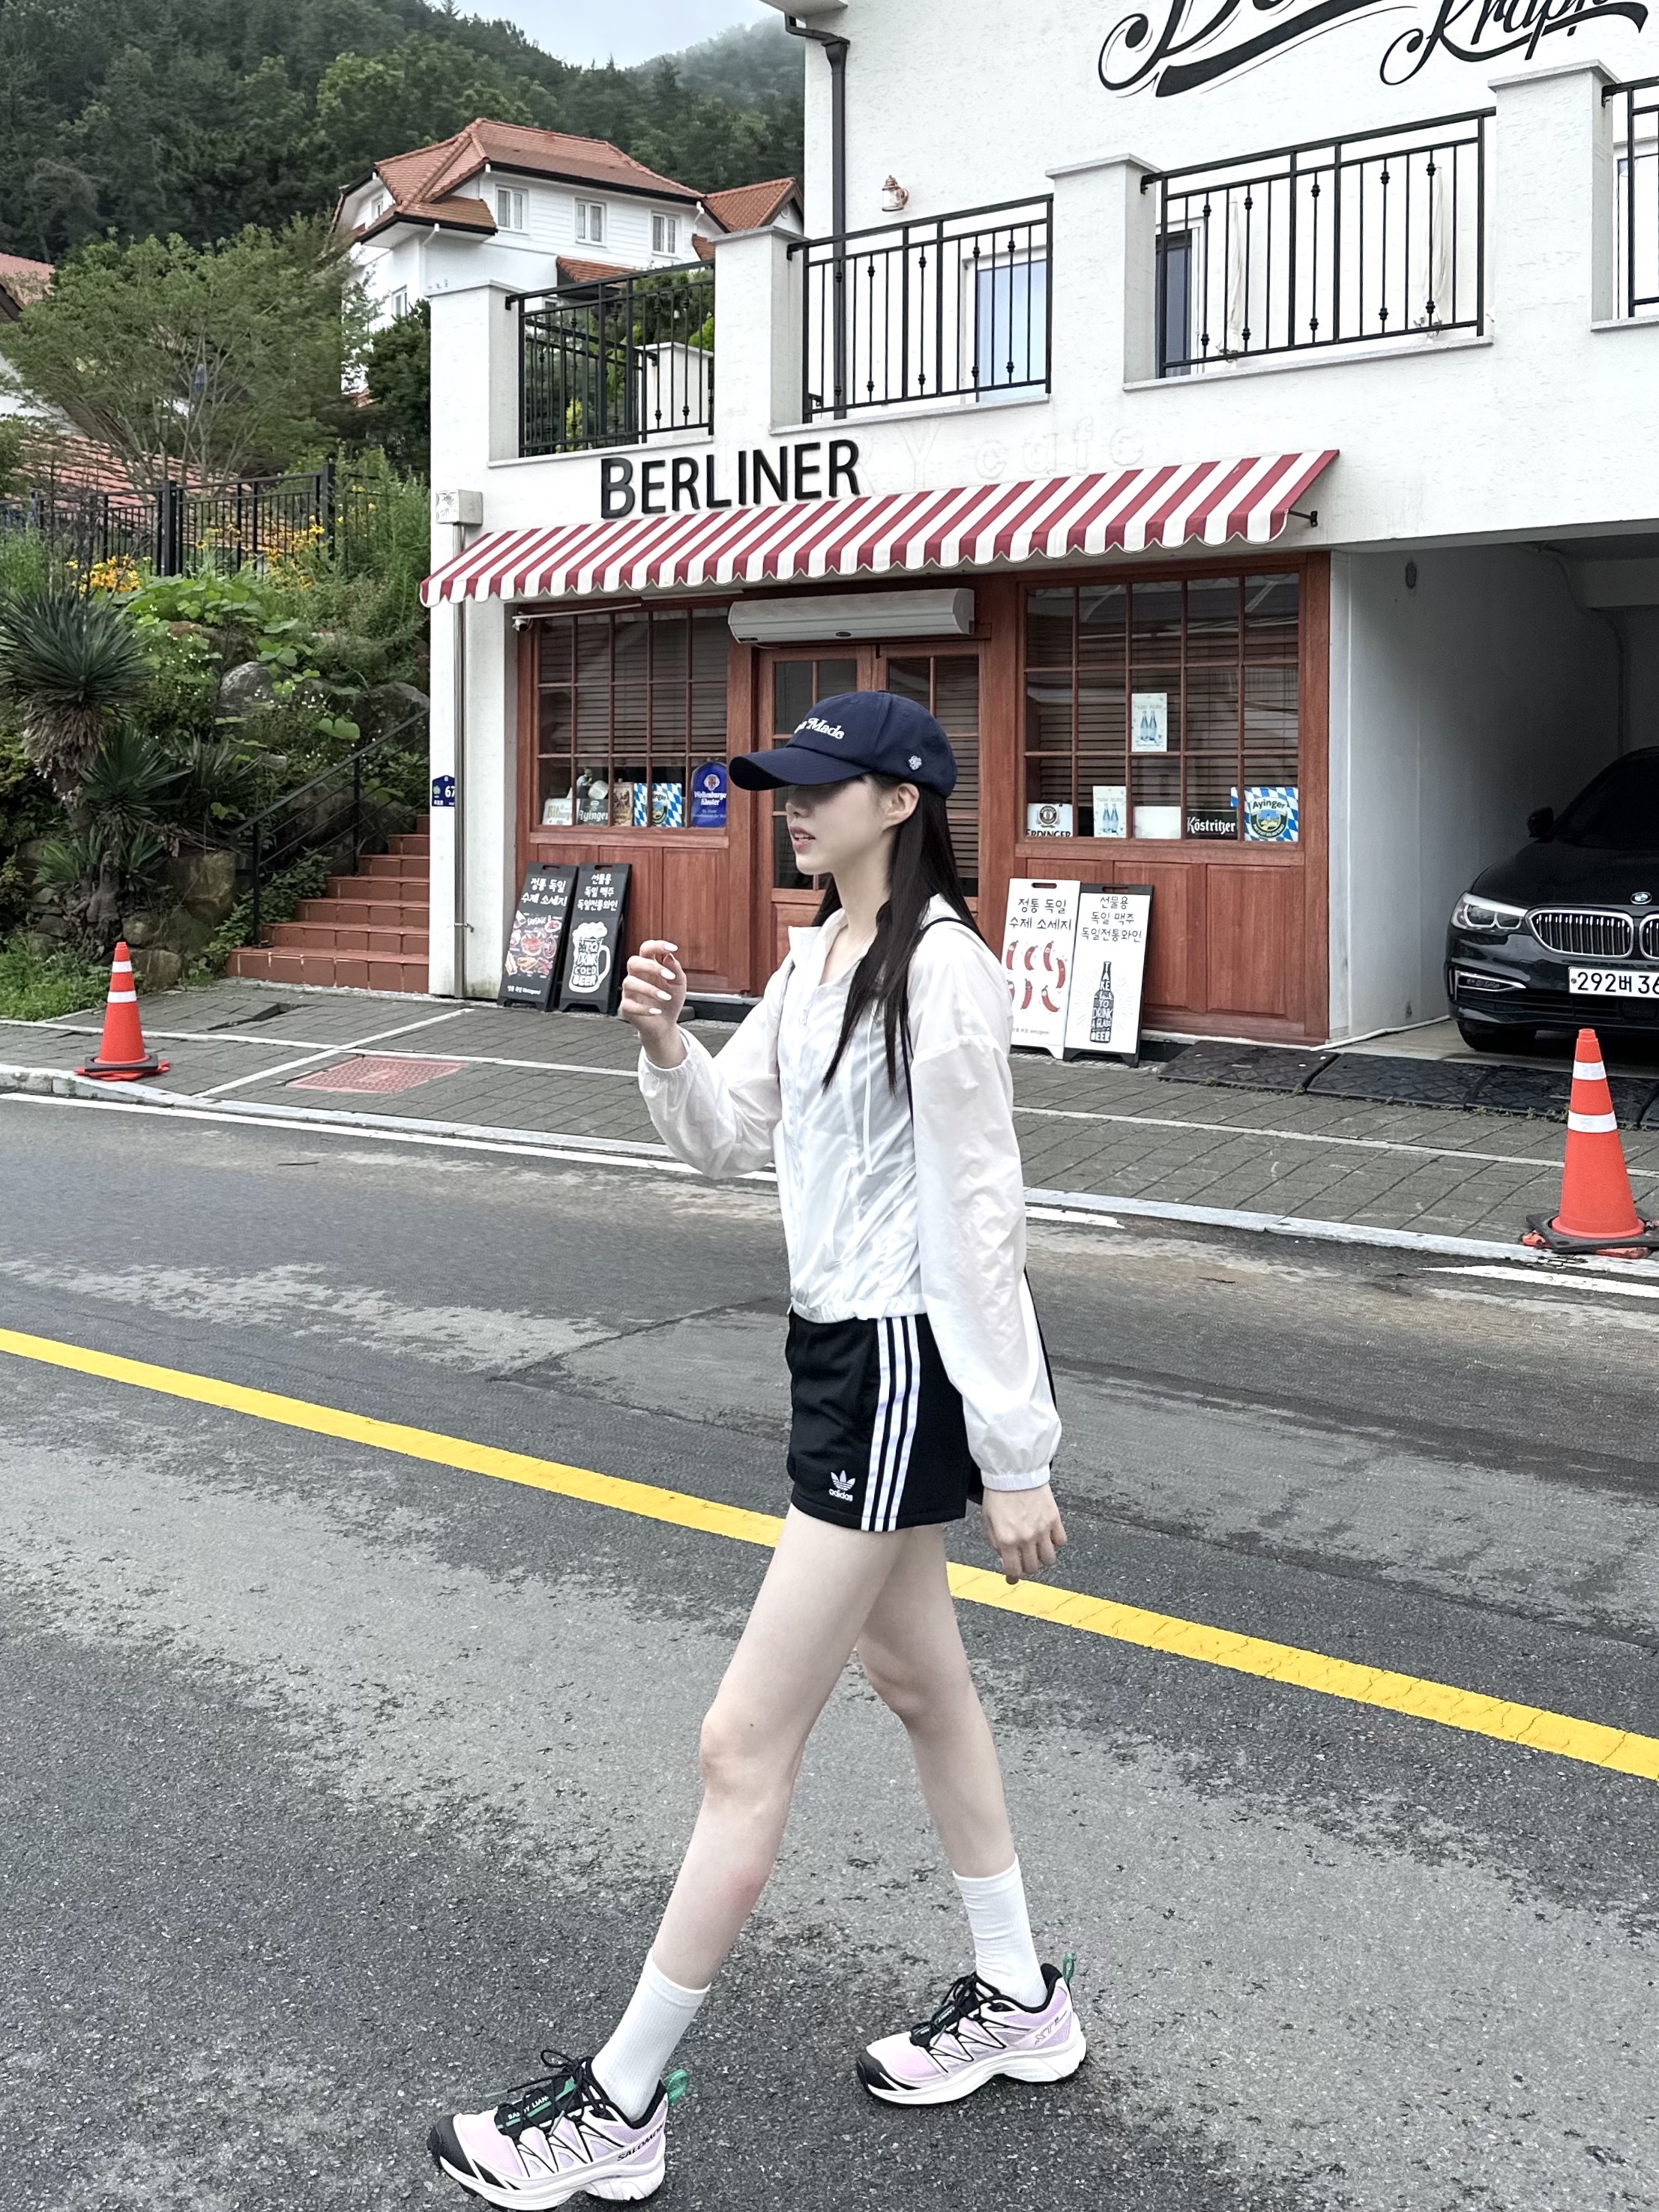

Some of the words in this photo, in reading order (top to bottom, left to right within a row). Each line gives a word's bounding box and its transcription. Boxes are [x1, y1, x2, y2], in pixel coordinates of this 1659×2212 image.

[601, 439, 861, 519] BERLINER
[806, 717, 845, 739] Made
[1253, 798, 1286, 810] Ayinger
[530, 878, 547, 891] 정통
[549, 879, 567, 893] 독일
[584, 886, 599, 898] 독일
[521, 892, 540, 903] 수제
[540, 895, 568, 907] 소세지
[1017, 898, 1039, 914] 정통
[1044, 899, 1067, 914] 독일
[1100, 896, 1129, 910] 선물용
[1009, 917, 1032, 929] 수제
[1036, 918, 1072, 930] 소세지
[1091, 911, 1110, 925] 독일
[1114, 913, 1135, 926] 맥주
[1081, 926, 1142, 943] 독일전통와인
[574, 966, 597, 974] COLD
[1577, 971, 1632, 992] 292버
[828, 1489, 853, 1501] adidas
[508, 2106, 530, 2120] SANY
[531, 2096, 550, 2109] LIAN
